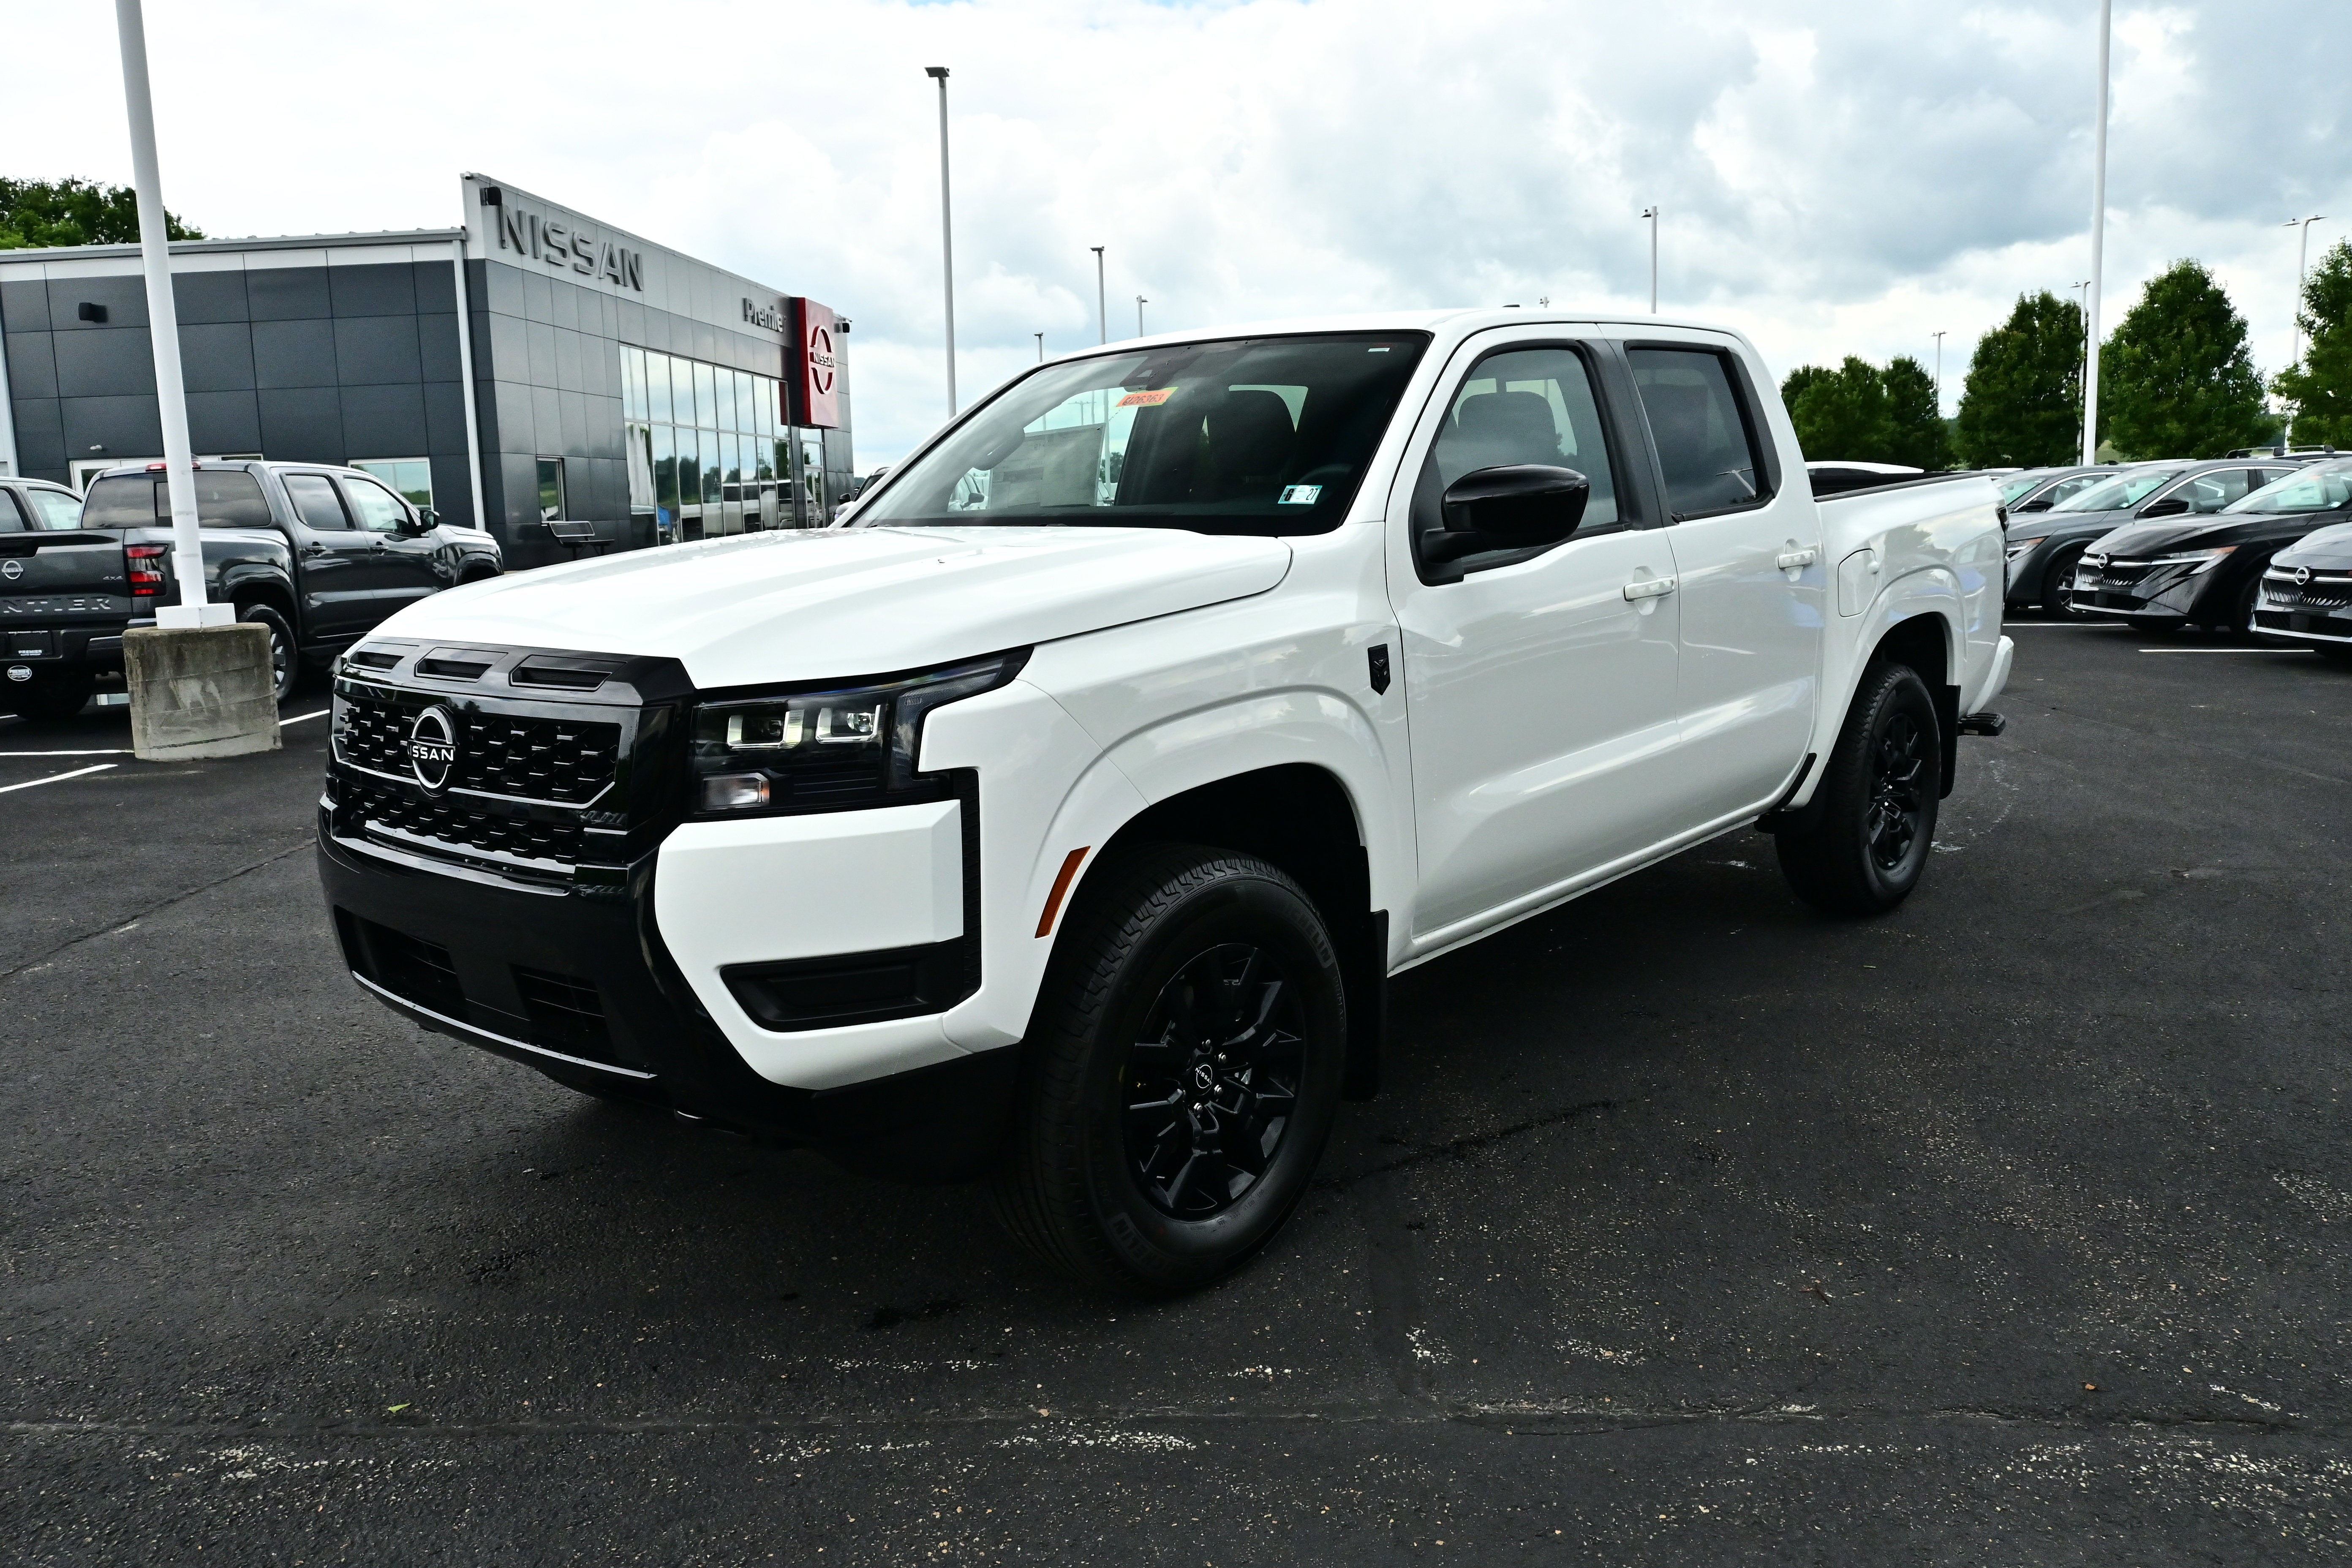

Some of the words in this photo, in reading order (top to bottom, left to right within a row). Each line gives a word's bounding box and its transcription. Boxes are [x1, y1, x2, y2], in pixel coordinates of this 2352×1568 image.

[497, 203, 643, 291] NISSAN
[742, 297, 787, 333] Premier
[813, 352, 835, 368] NISSAN
[1306, 488, 1319, 501] 27
[407, 745, 454, 761] ISSAN
[1195, 1067, 1212, 1085] NISSAN
